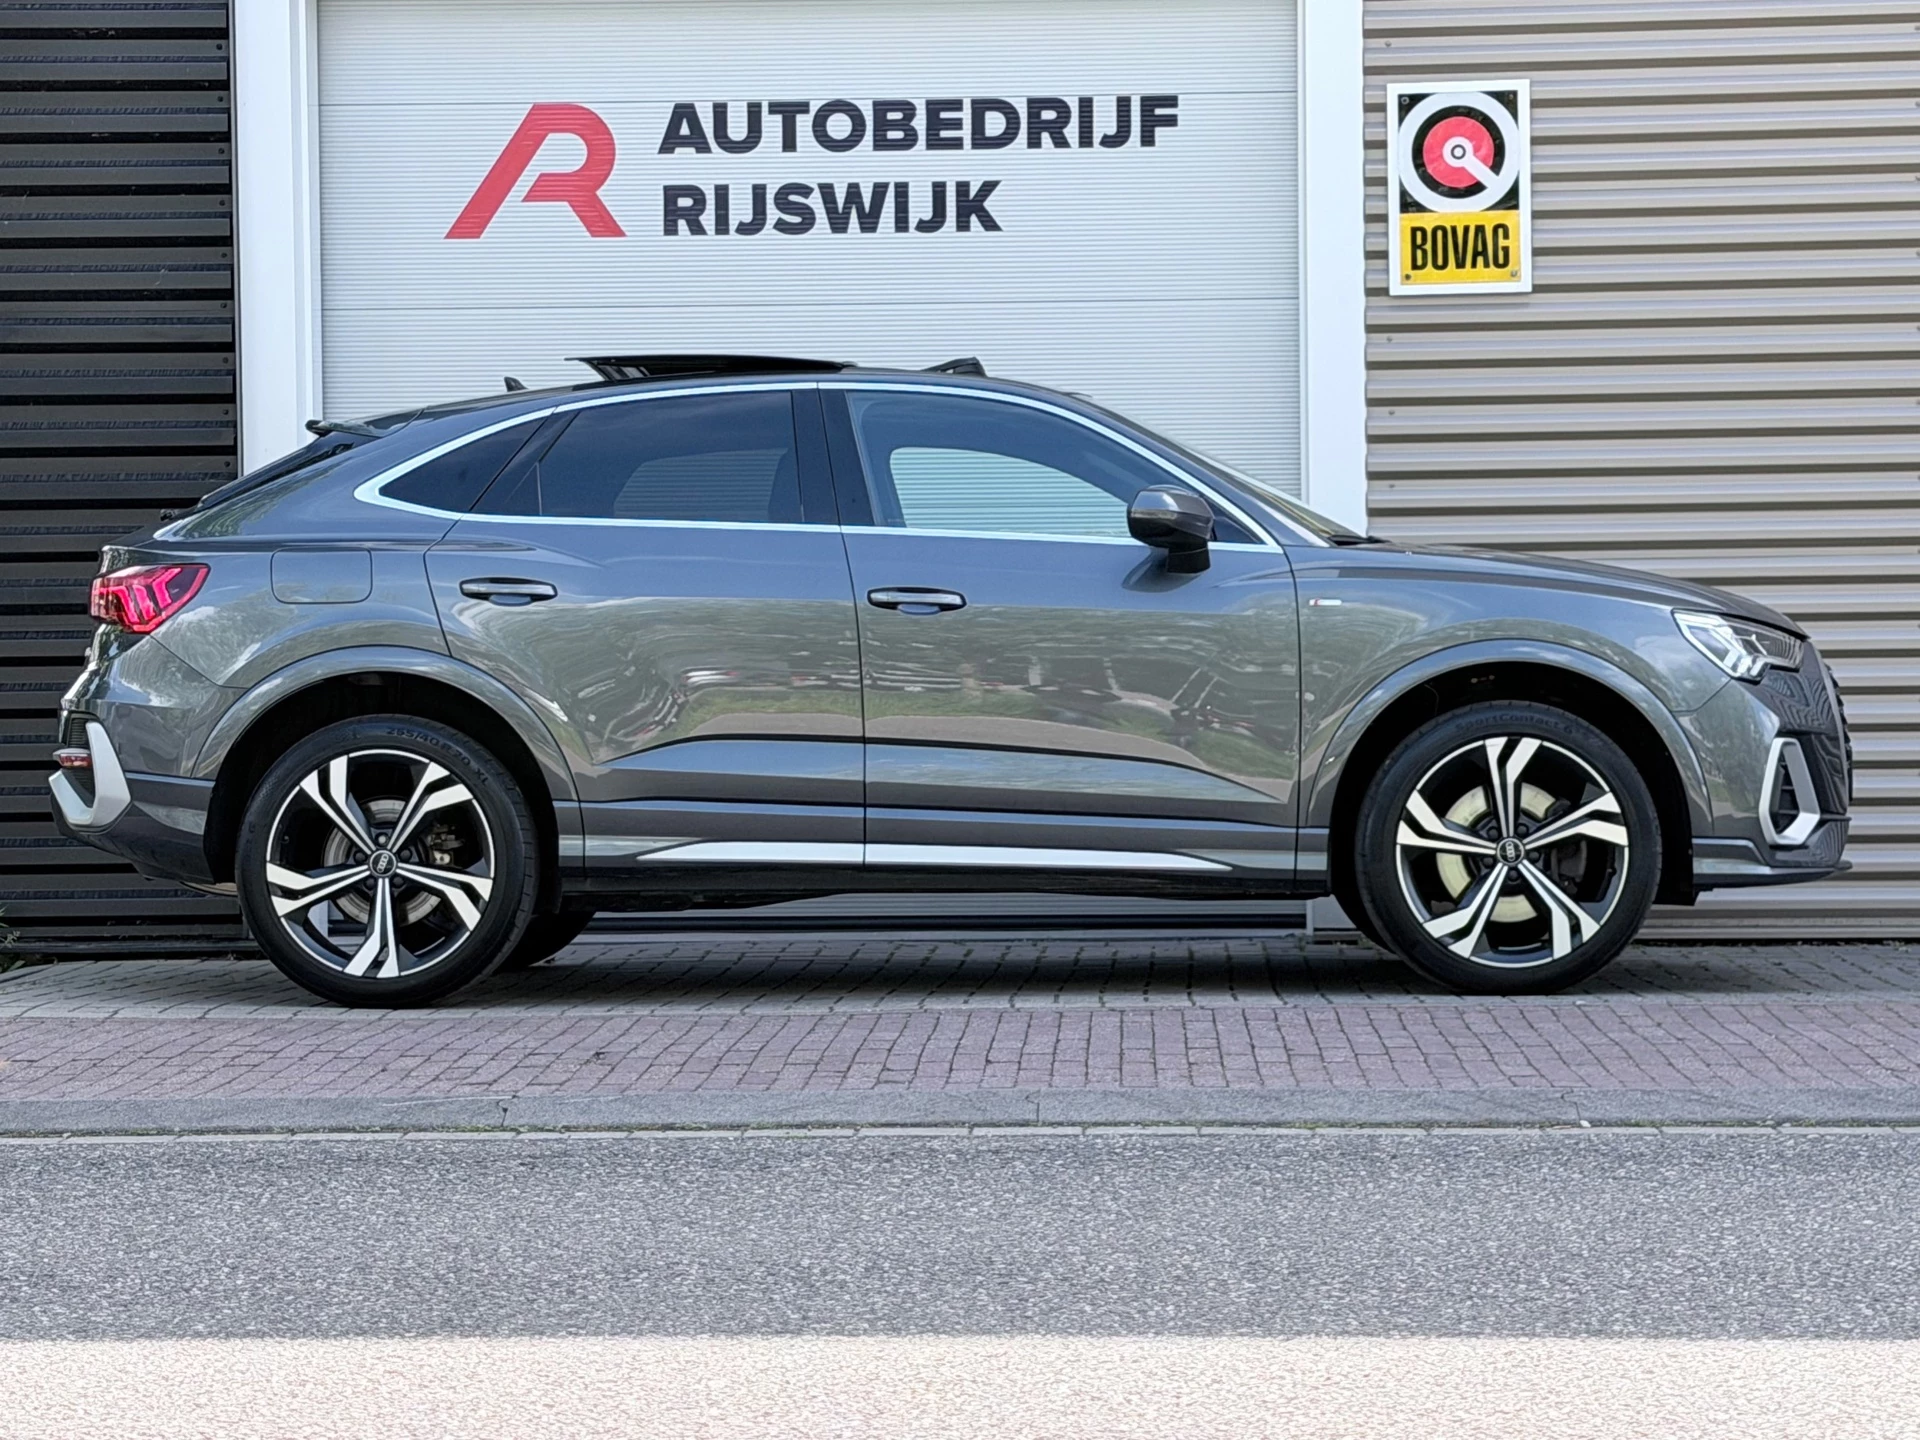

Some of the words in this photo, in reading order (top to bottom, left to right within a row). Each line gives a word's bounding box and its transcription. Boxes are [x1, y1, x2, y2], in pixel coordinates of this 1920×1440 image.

[657, 96, 1179, 154] AUTOBEDRIJF
[663, 180, 1004, 237] RIJSWIJK
[1410, 223, 1510, 270] BOVAG
